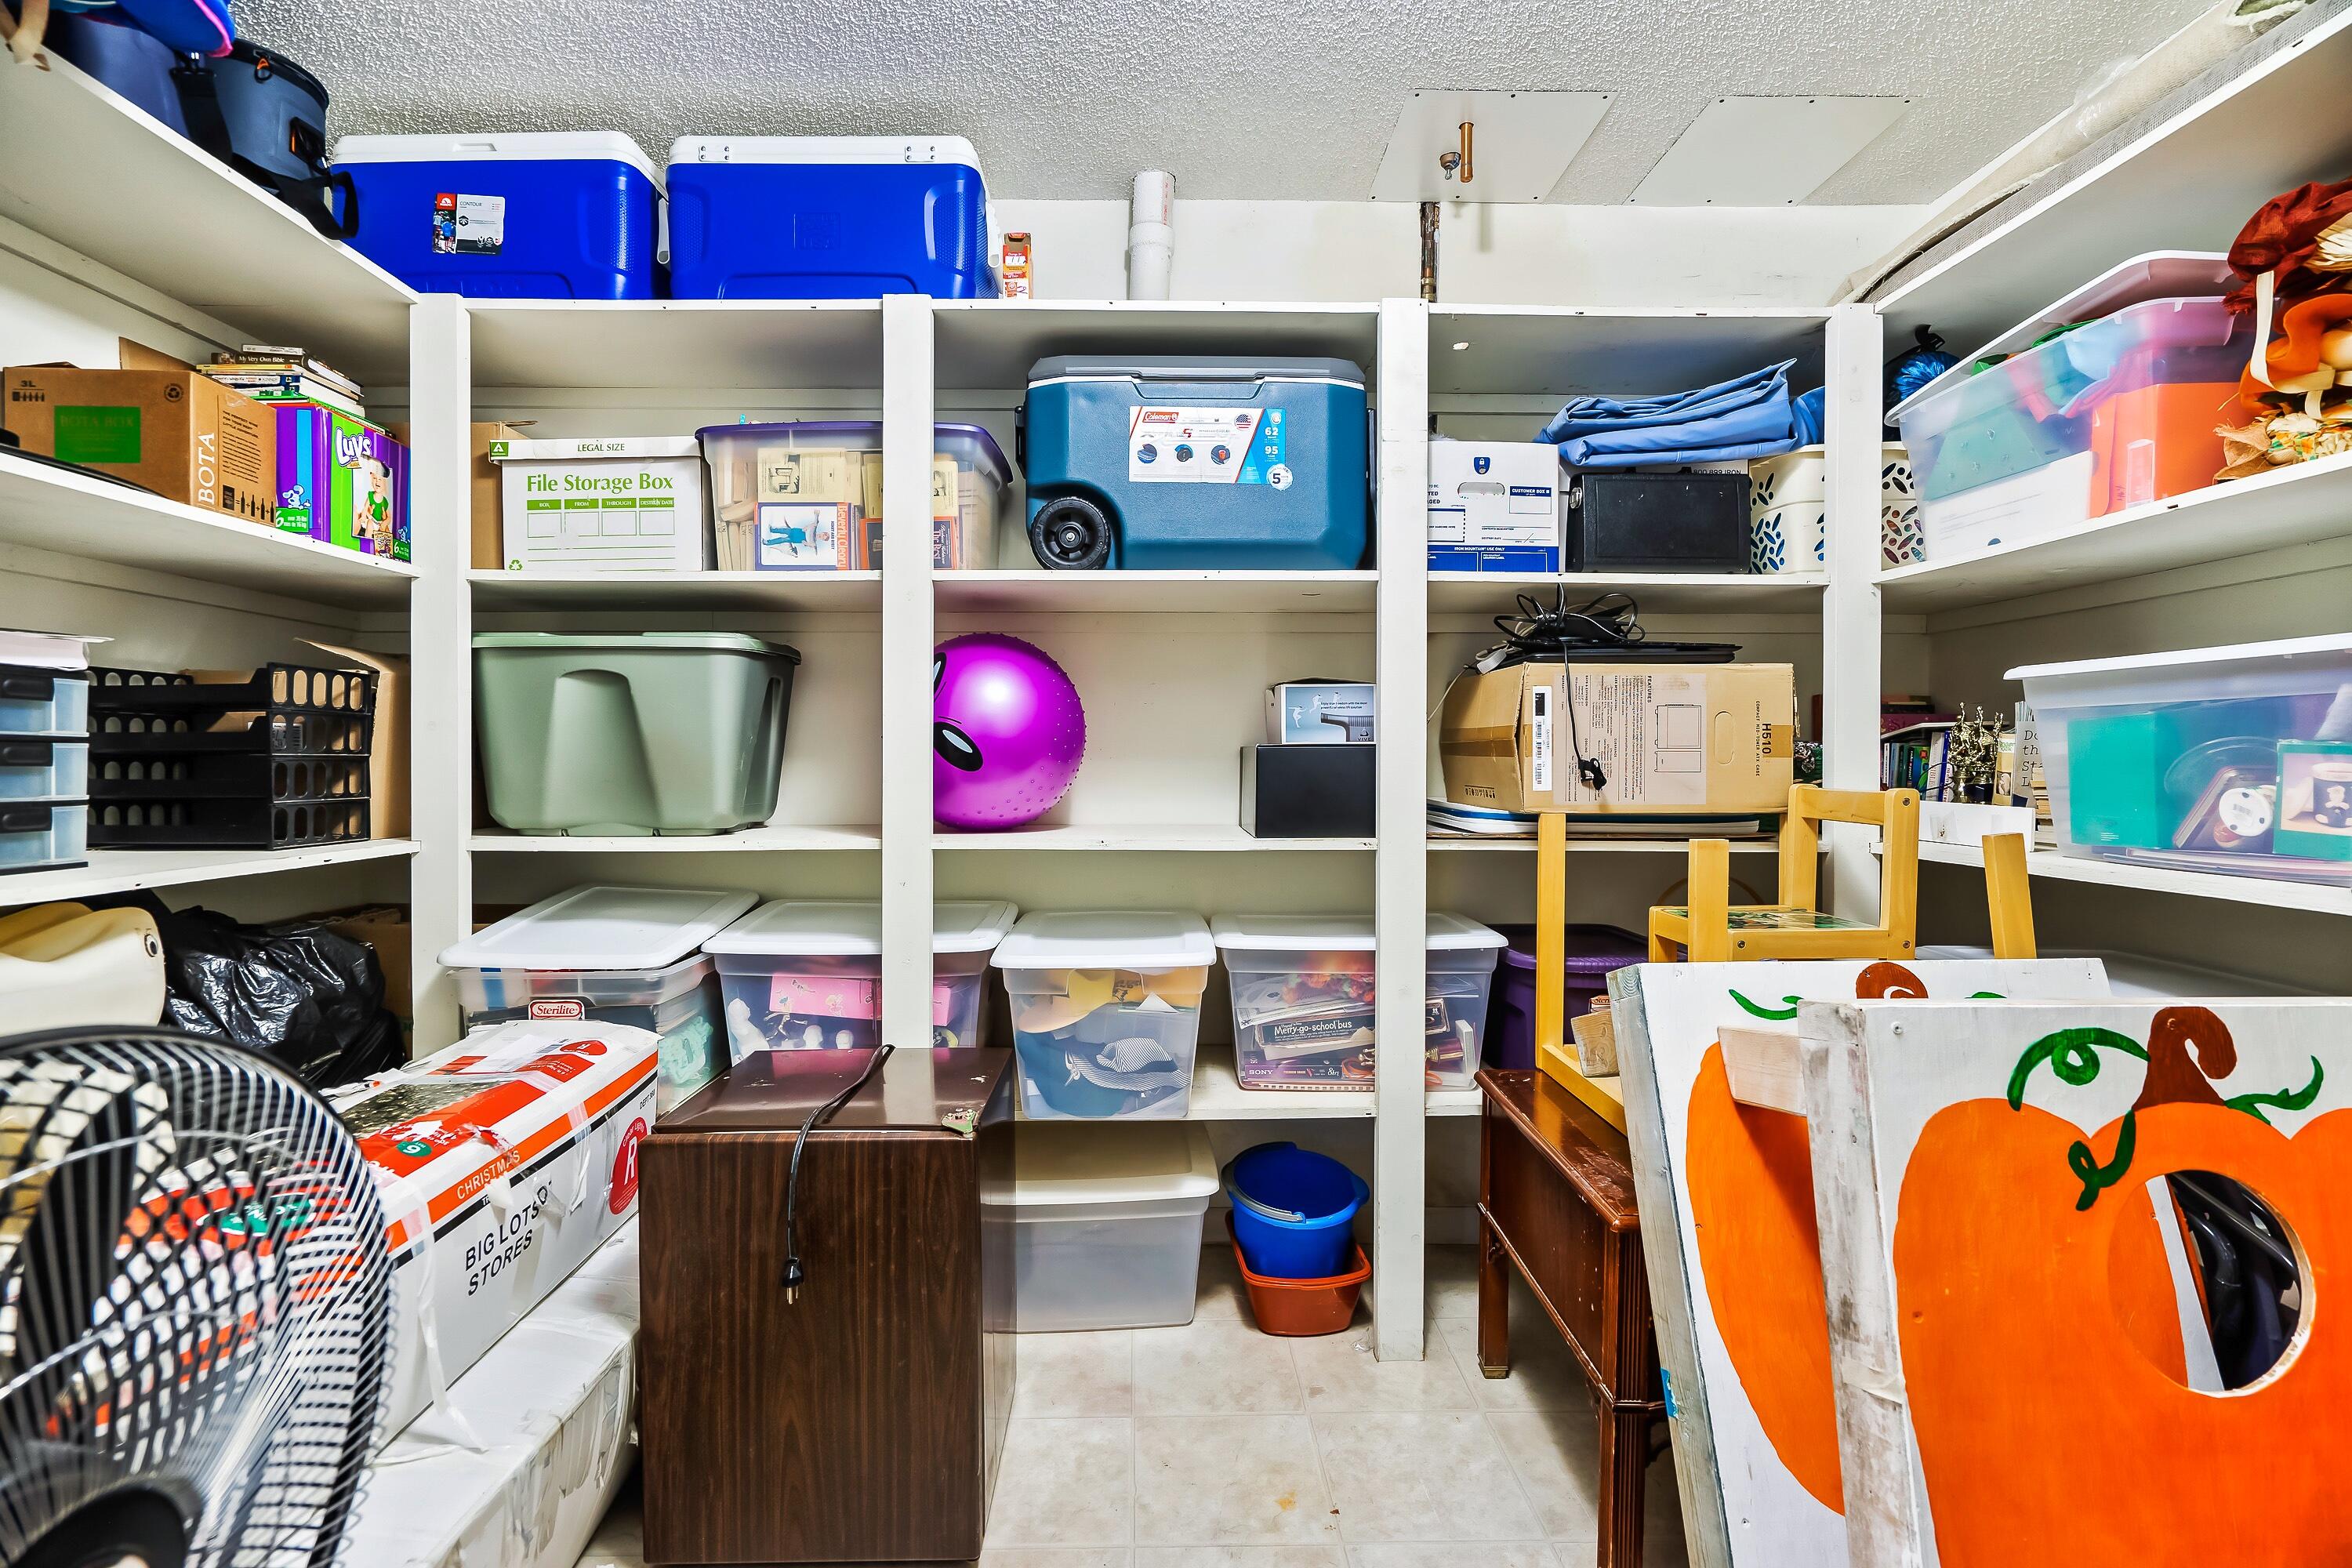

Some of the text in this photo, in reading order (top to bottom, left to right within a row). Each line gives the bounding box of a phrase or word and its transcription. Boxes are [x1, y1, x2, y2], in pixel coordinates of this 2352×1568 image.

[1145, 412, 1173, 422] Coleman
[1265, 427, 1279, 436] 62
[336, 426, 372, 467] Luvs
[577, 443, 625, 452] LEGAL SIZE
[1265, 446, 1279, 455] 95
[198, 432, 216, 506] BOTA
[1272, 473, 1281, 484] 5
[527, 473, 673, 494] File Storage Box
[276, 510, 285, 528] 6
[836, 506, 848, 568] Beverly Cleary
[1762, 723, 1772, 754] H510
[536, 1004, 575, 1014] Sterilite
[1274, 1020, 1336, 1036] Merry-go-school
[1338, 1020, 1352, 1029] bus
[624, 1135, 637, 1185] R
[456, 1149, 521, 1200] CHRISTMAS
[465, 1200, 539, 1272] BIG LOTS
[467, 1229, 533, 1297] STORES
